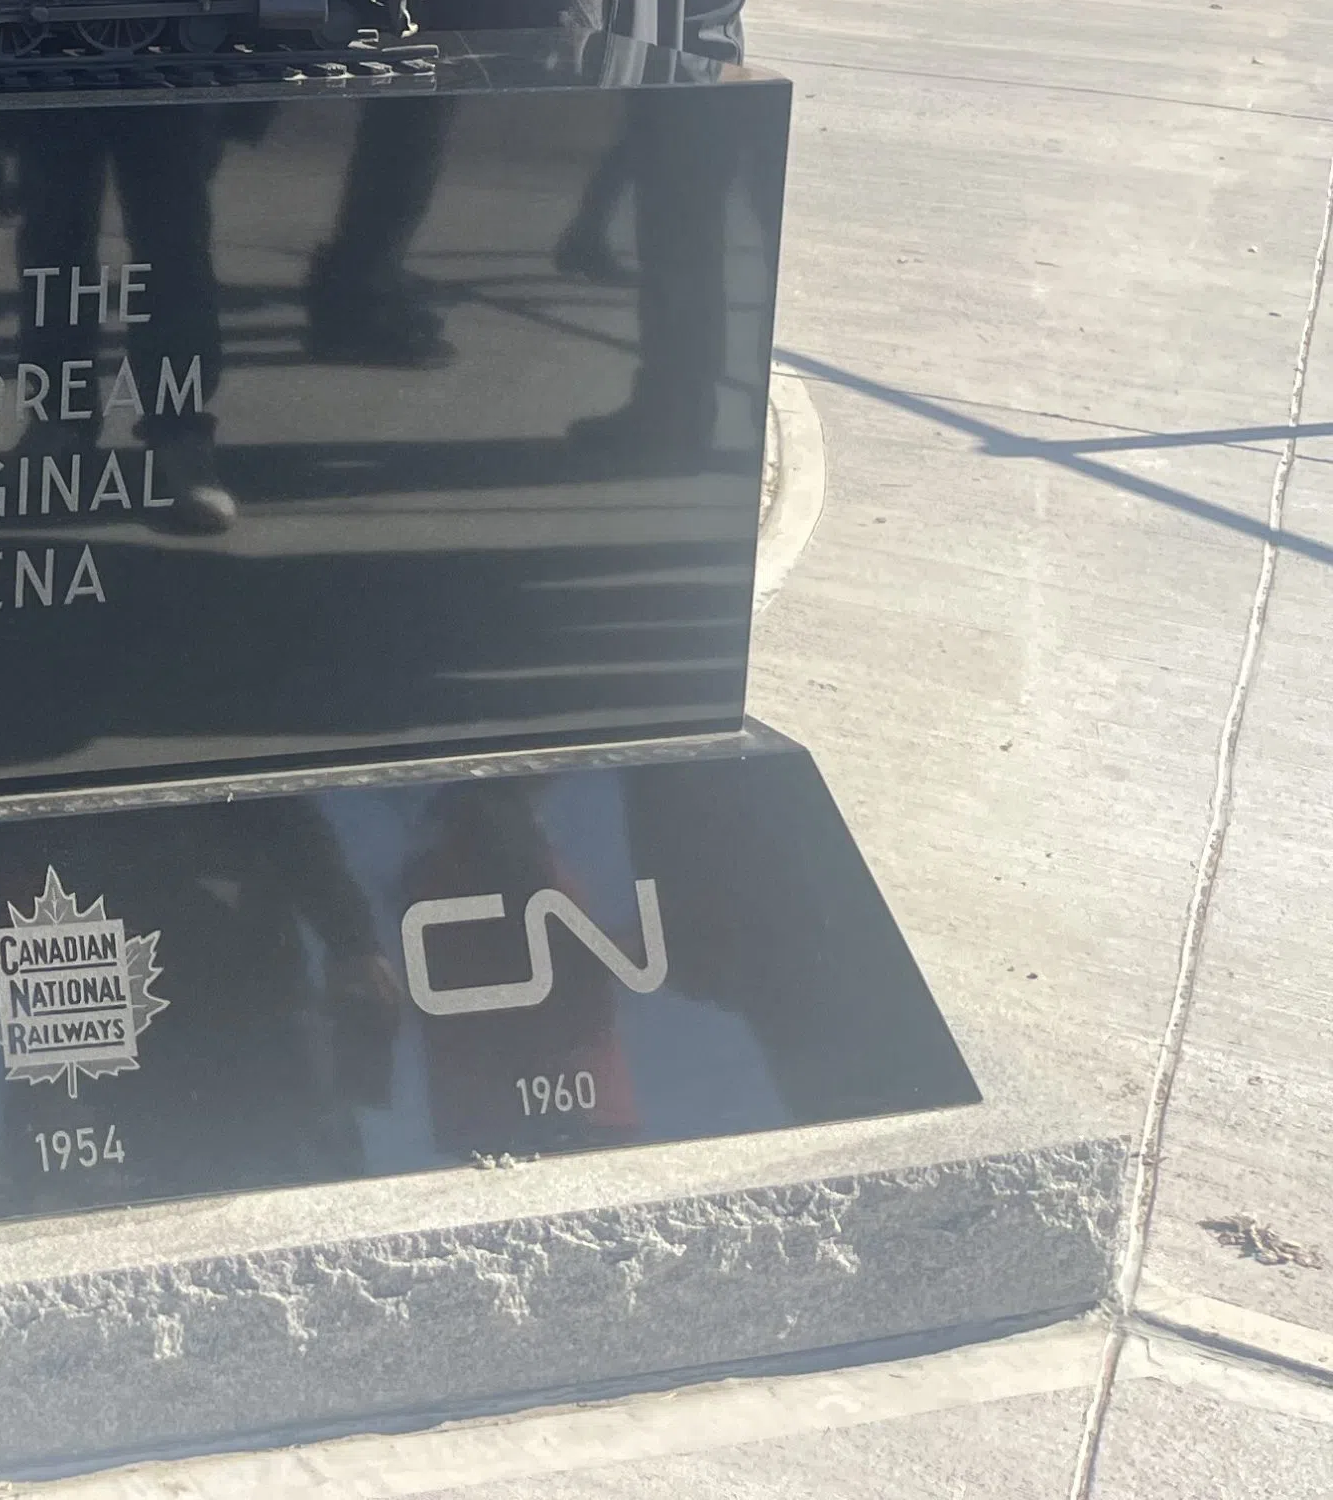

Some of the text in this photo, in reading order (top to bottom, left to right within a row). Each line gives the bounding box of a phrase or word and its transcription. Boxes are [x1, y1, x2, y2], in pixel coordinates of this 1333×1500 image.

[23, 263, 152, 327] THE
[0, 932, 118, 976] CANADIAN
[401, 878, 668, 1015] CN
[9, 976, 127, 1018] NATIONAL
[7, 1018, 126, 1055] RAILWAYS
[516, 1070, 596, 1116] 1960
[35, 1124, 126, 1173] 1954
